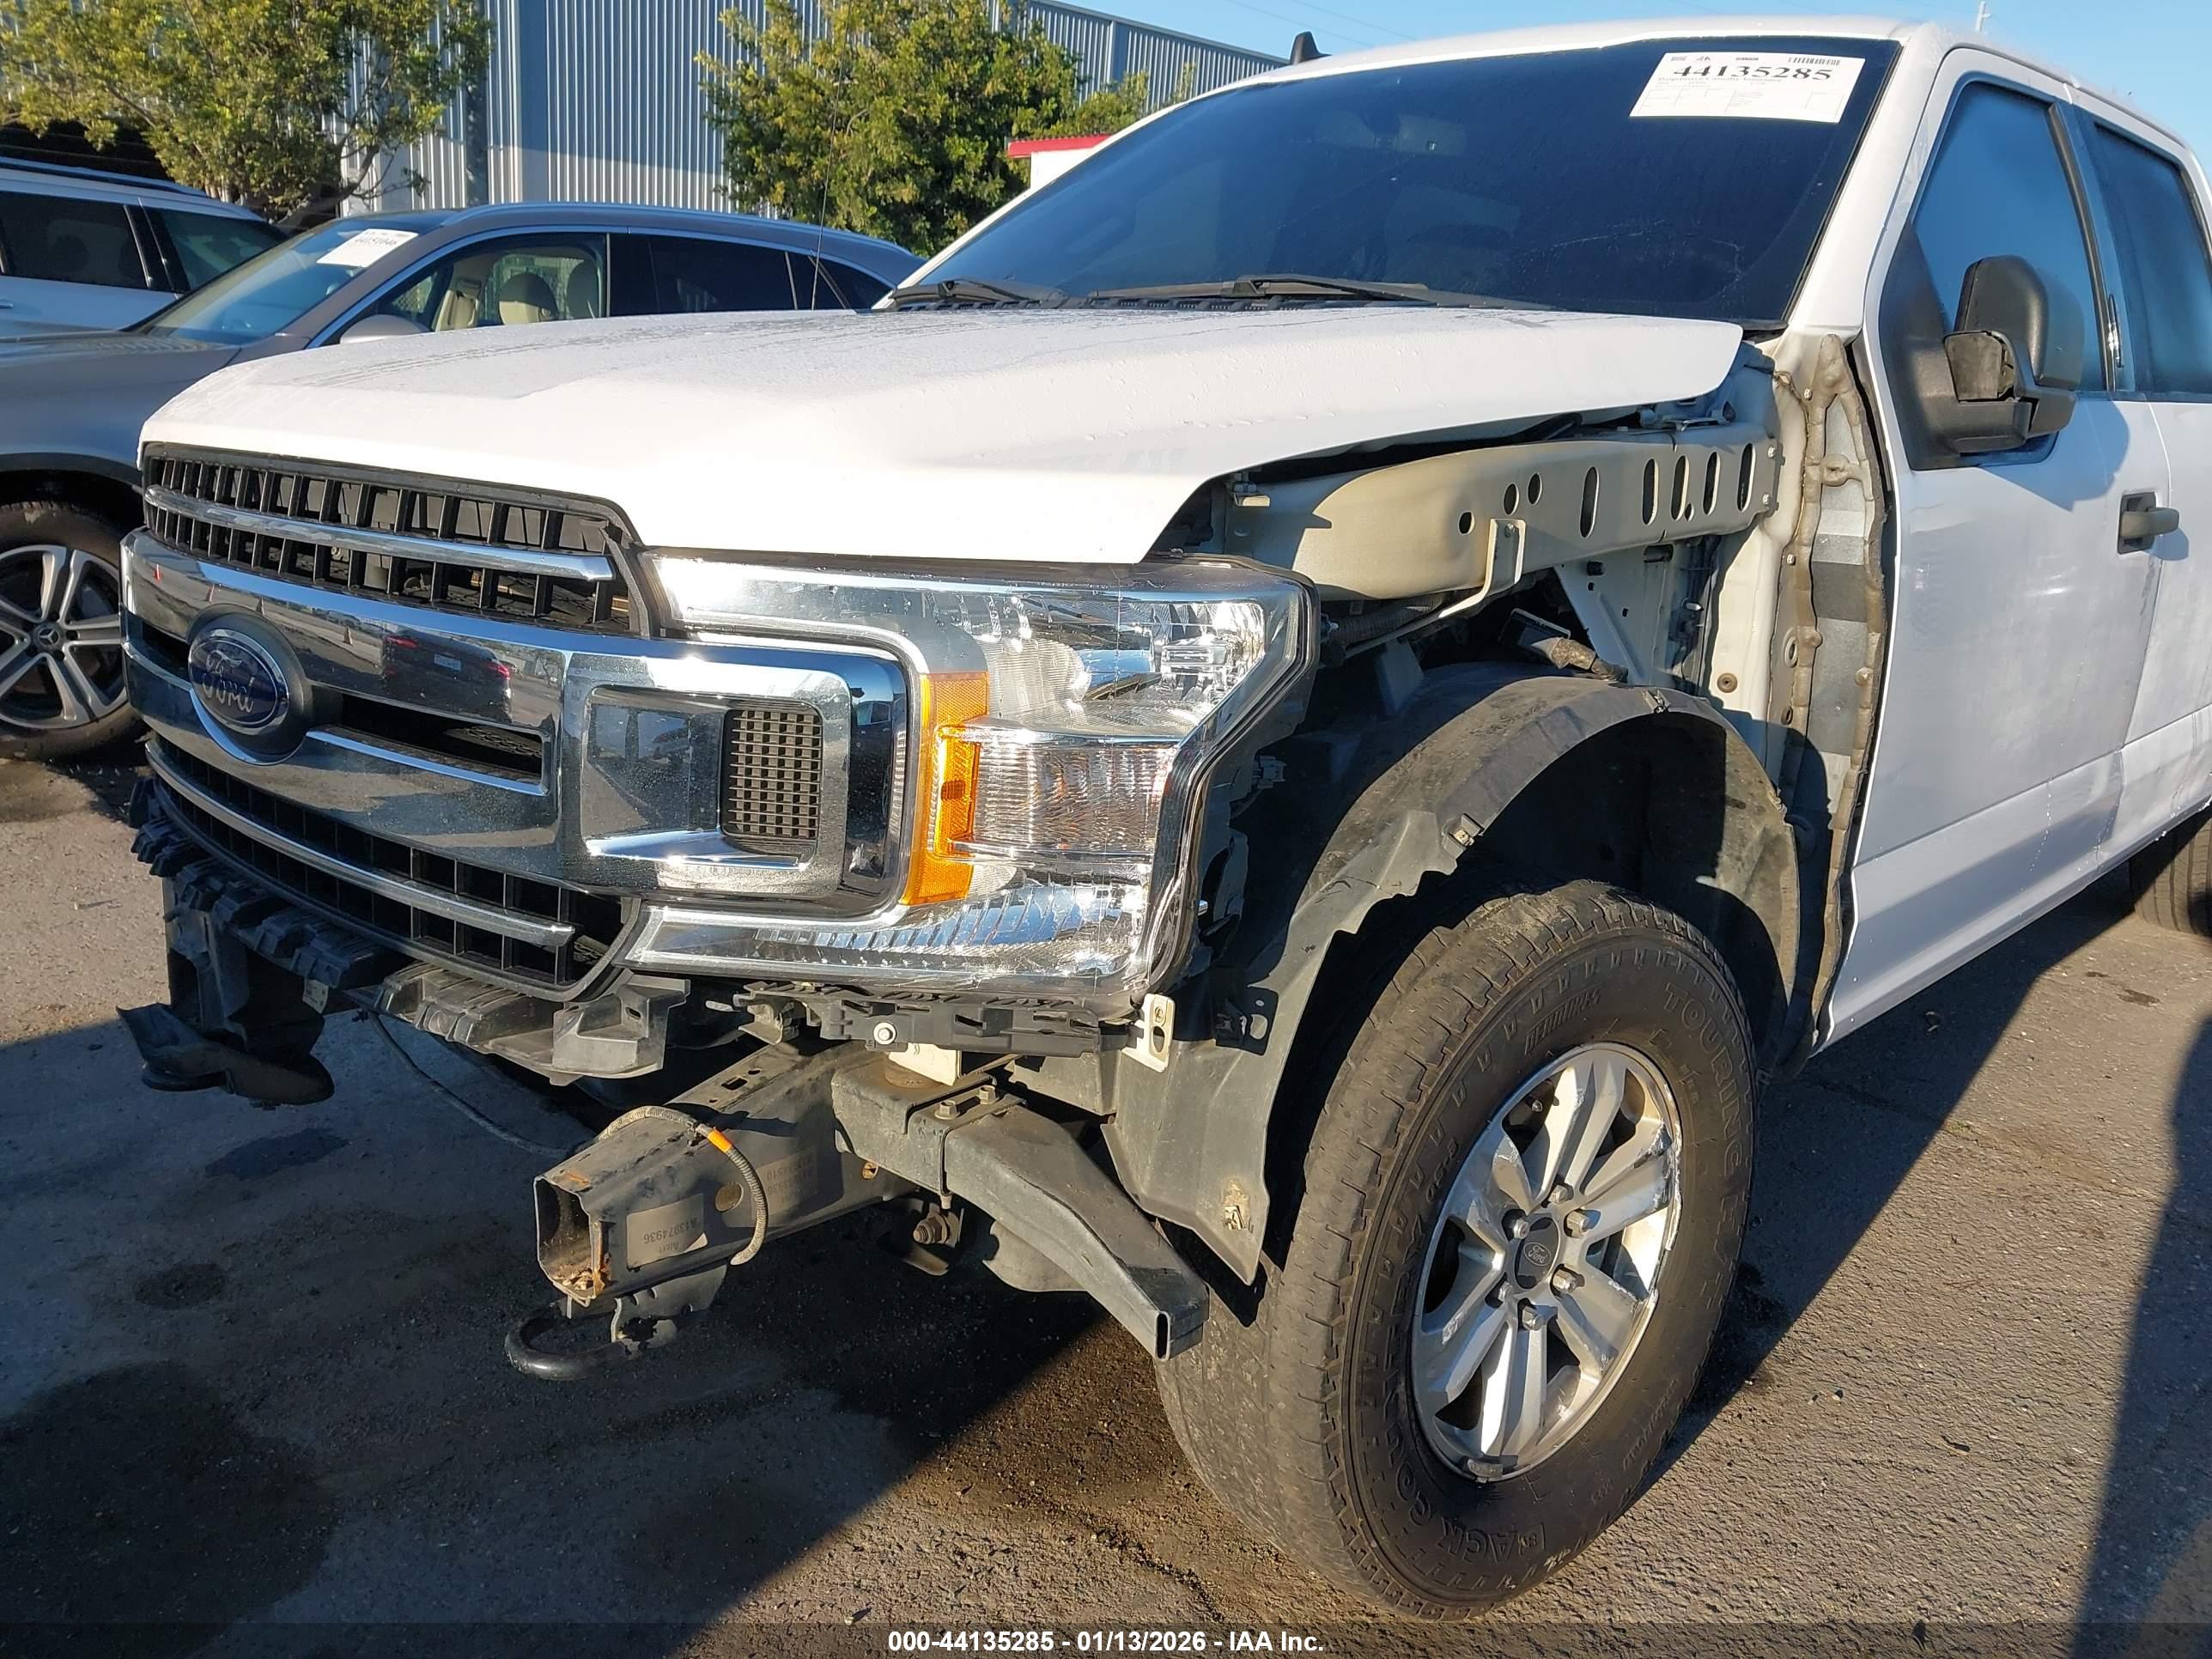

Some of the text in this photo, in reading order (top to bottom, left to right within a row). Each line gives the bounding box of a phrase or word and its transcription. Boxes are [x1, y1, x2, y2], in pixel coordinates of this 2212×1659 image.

[1674, 65, 1833, 80] 44135285
[201, 649, 256, 713] Ford
[1528, 1245, 1547, 1263] Ford
